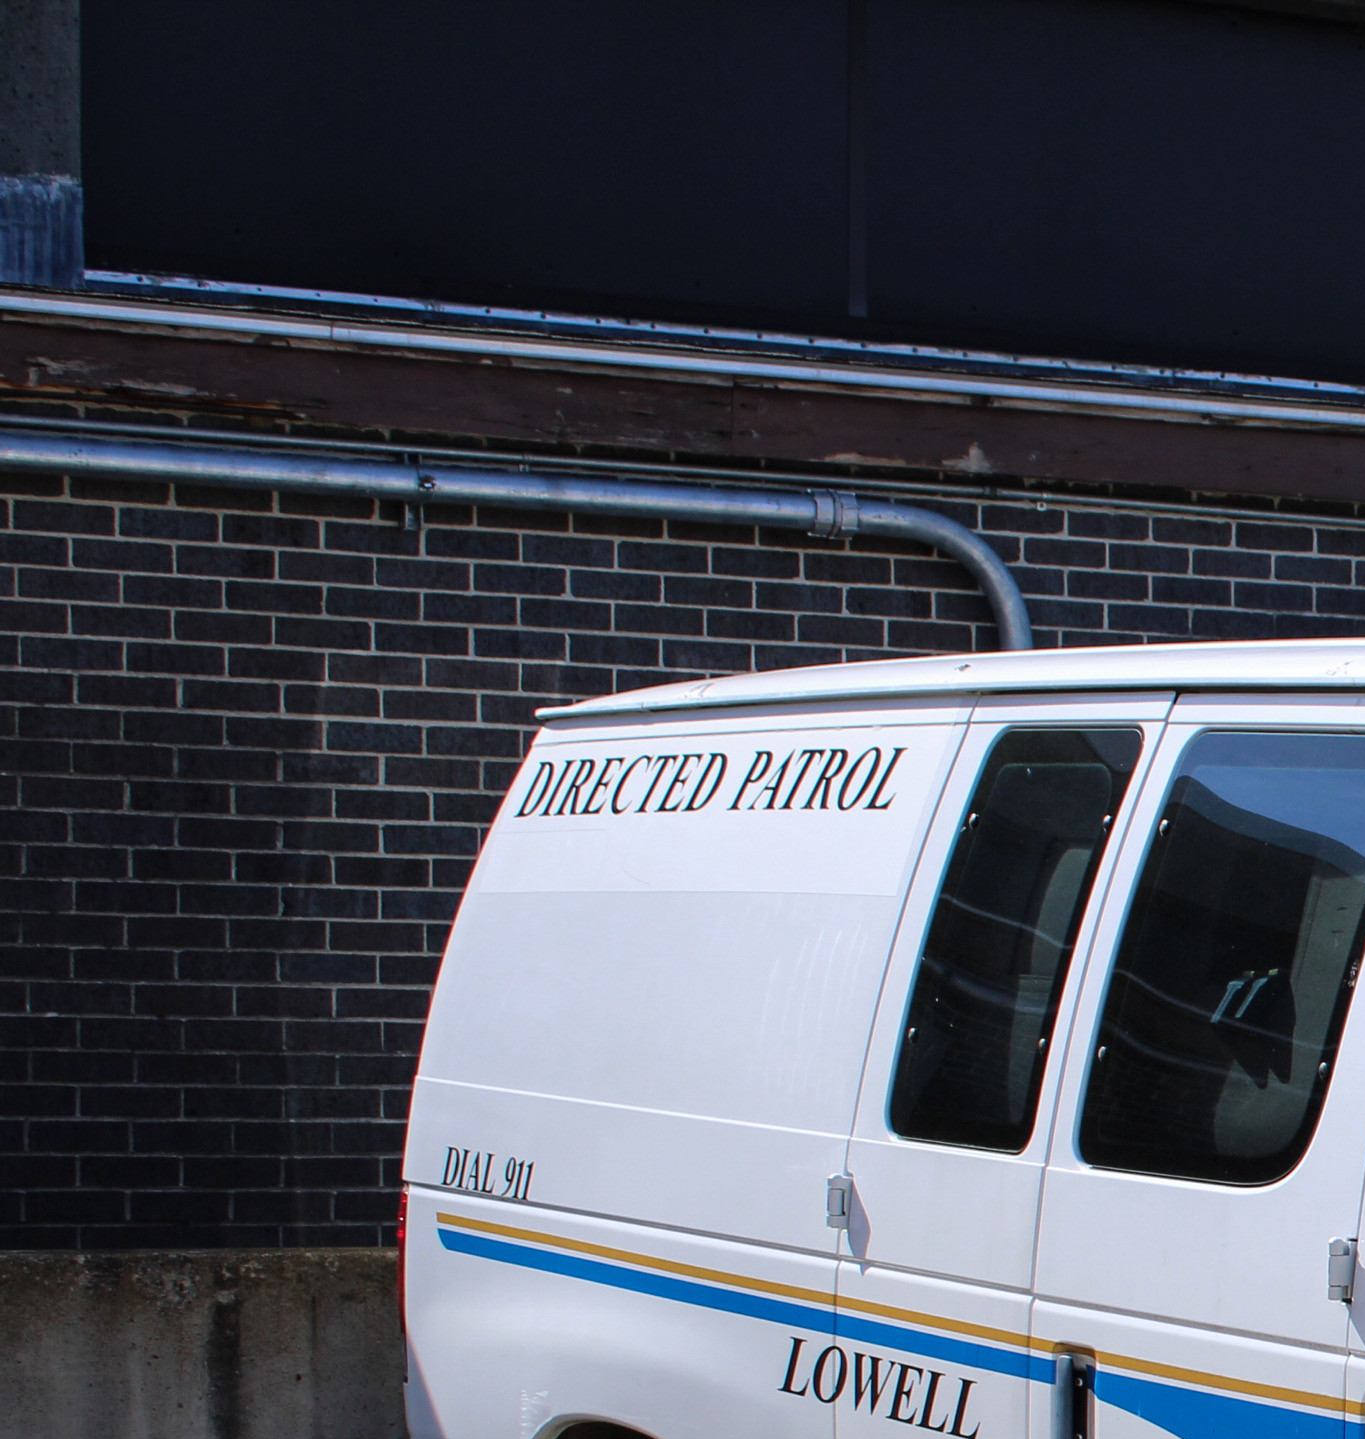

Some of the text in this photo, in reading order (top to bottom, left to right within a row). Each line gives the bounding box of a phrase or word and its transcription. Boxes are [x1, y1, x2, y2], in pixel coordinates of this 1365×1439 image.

[515, 747, 908, 817] DIRECTED PATROL
[441, 1146, 535, 1200] DIAL 911
